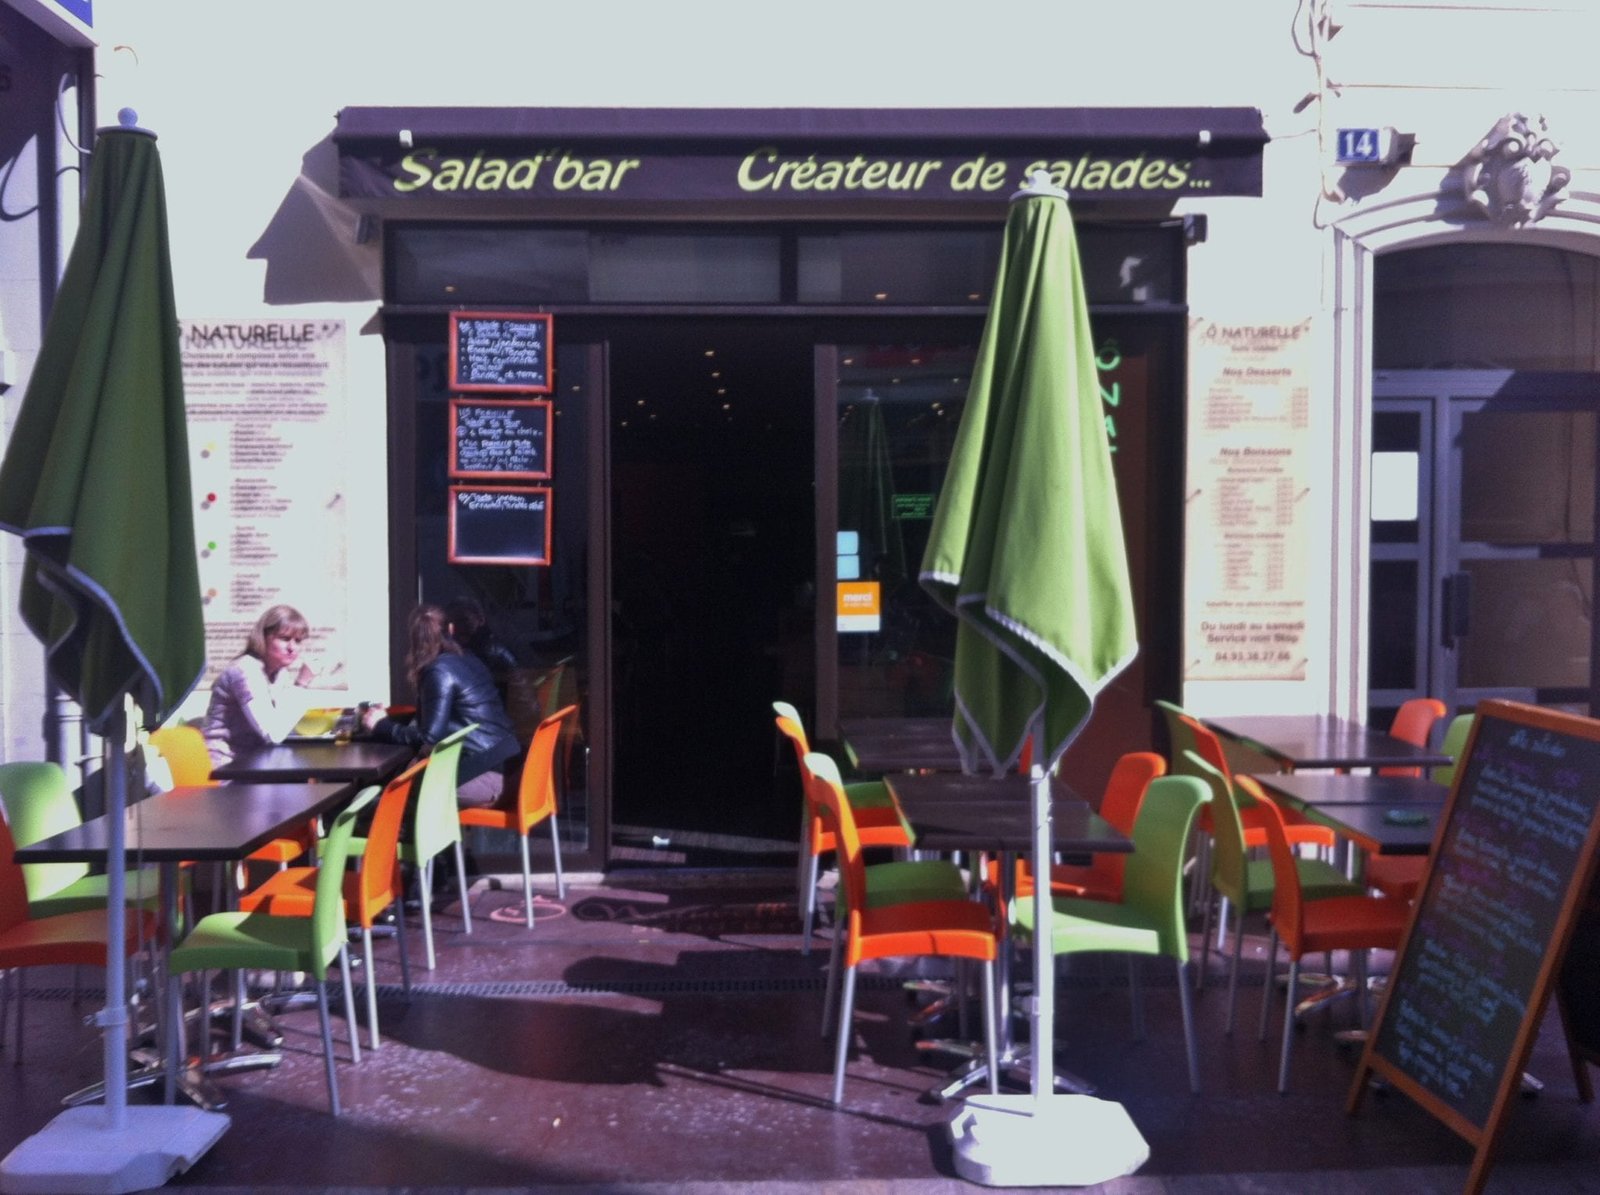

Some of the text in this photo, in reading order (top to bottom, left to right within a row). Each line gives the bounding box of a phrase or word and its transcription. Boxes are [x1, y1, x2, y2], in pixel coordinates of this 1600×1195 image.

[1345, 131, 1374, 157] 14
[736, 146, 942, 192] Créateur
[950, 153, 1008, 192] de
[191, 323, 315, 342] NATURELLE
[1221, 325, 1302, 340] NATURELLE
[843, 592, 873, 603] merci
